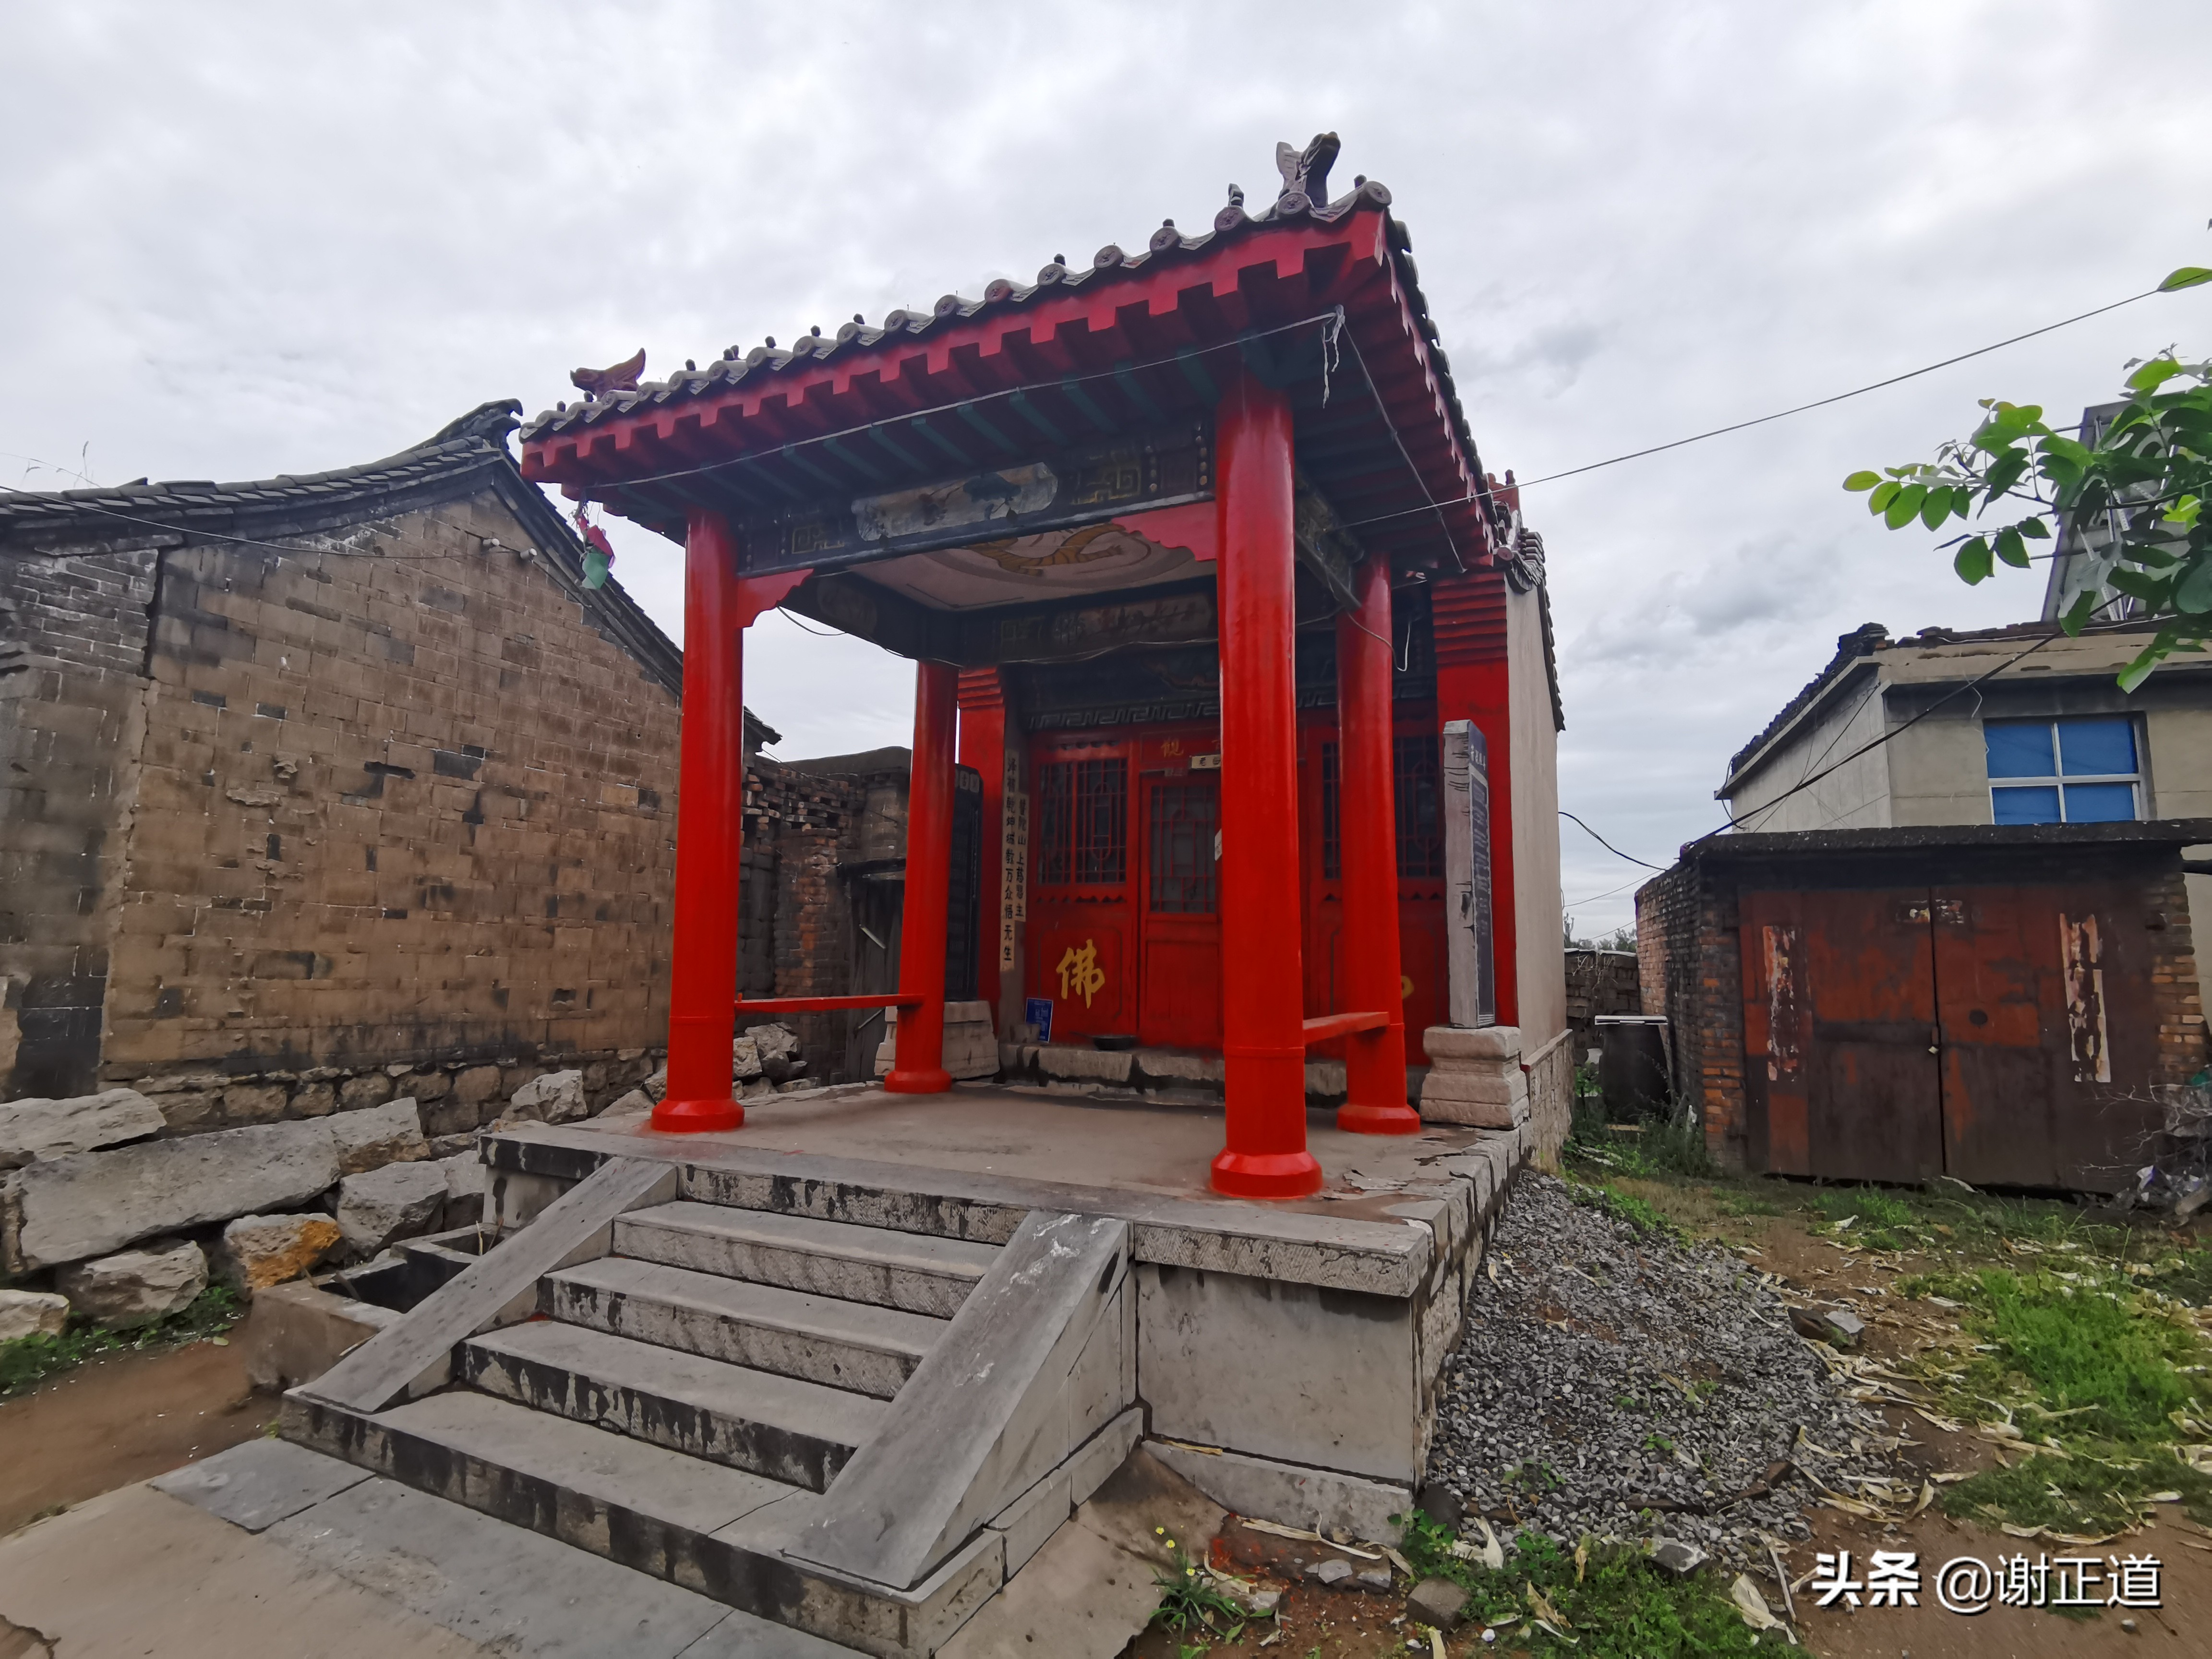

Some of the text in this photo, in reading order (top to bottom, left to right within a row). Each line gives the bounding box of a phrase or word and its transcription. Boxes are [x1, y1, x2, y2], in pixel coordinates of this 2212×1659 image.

[1015, 798, 1027, 917] 普陀山上慈悲主
[1056, 939, 1105, 1009] 佛
